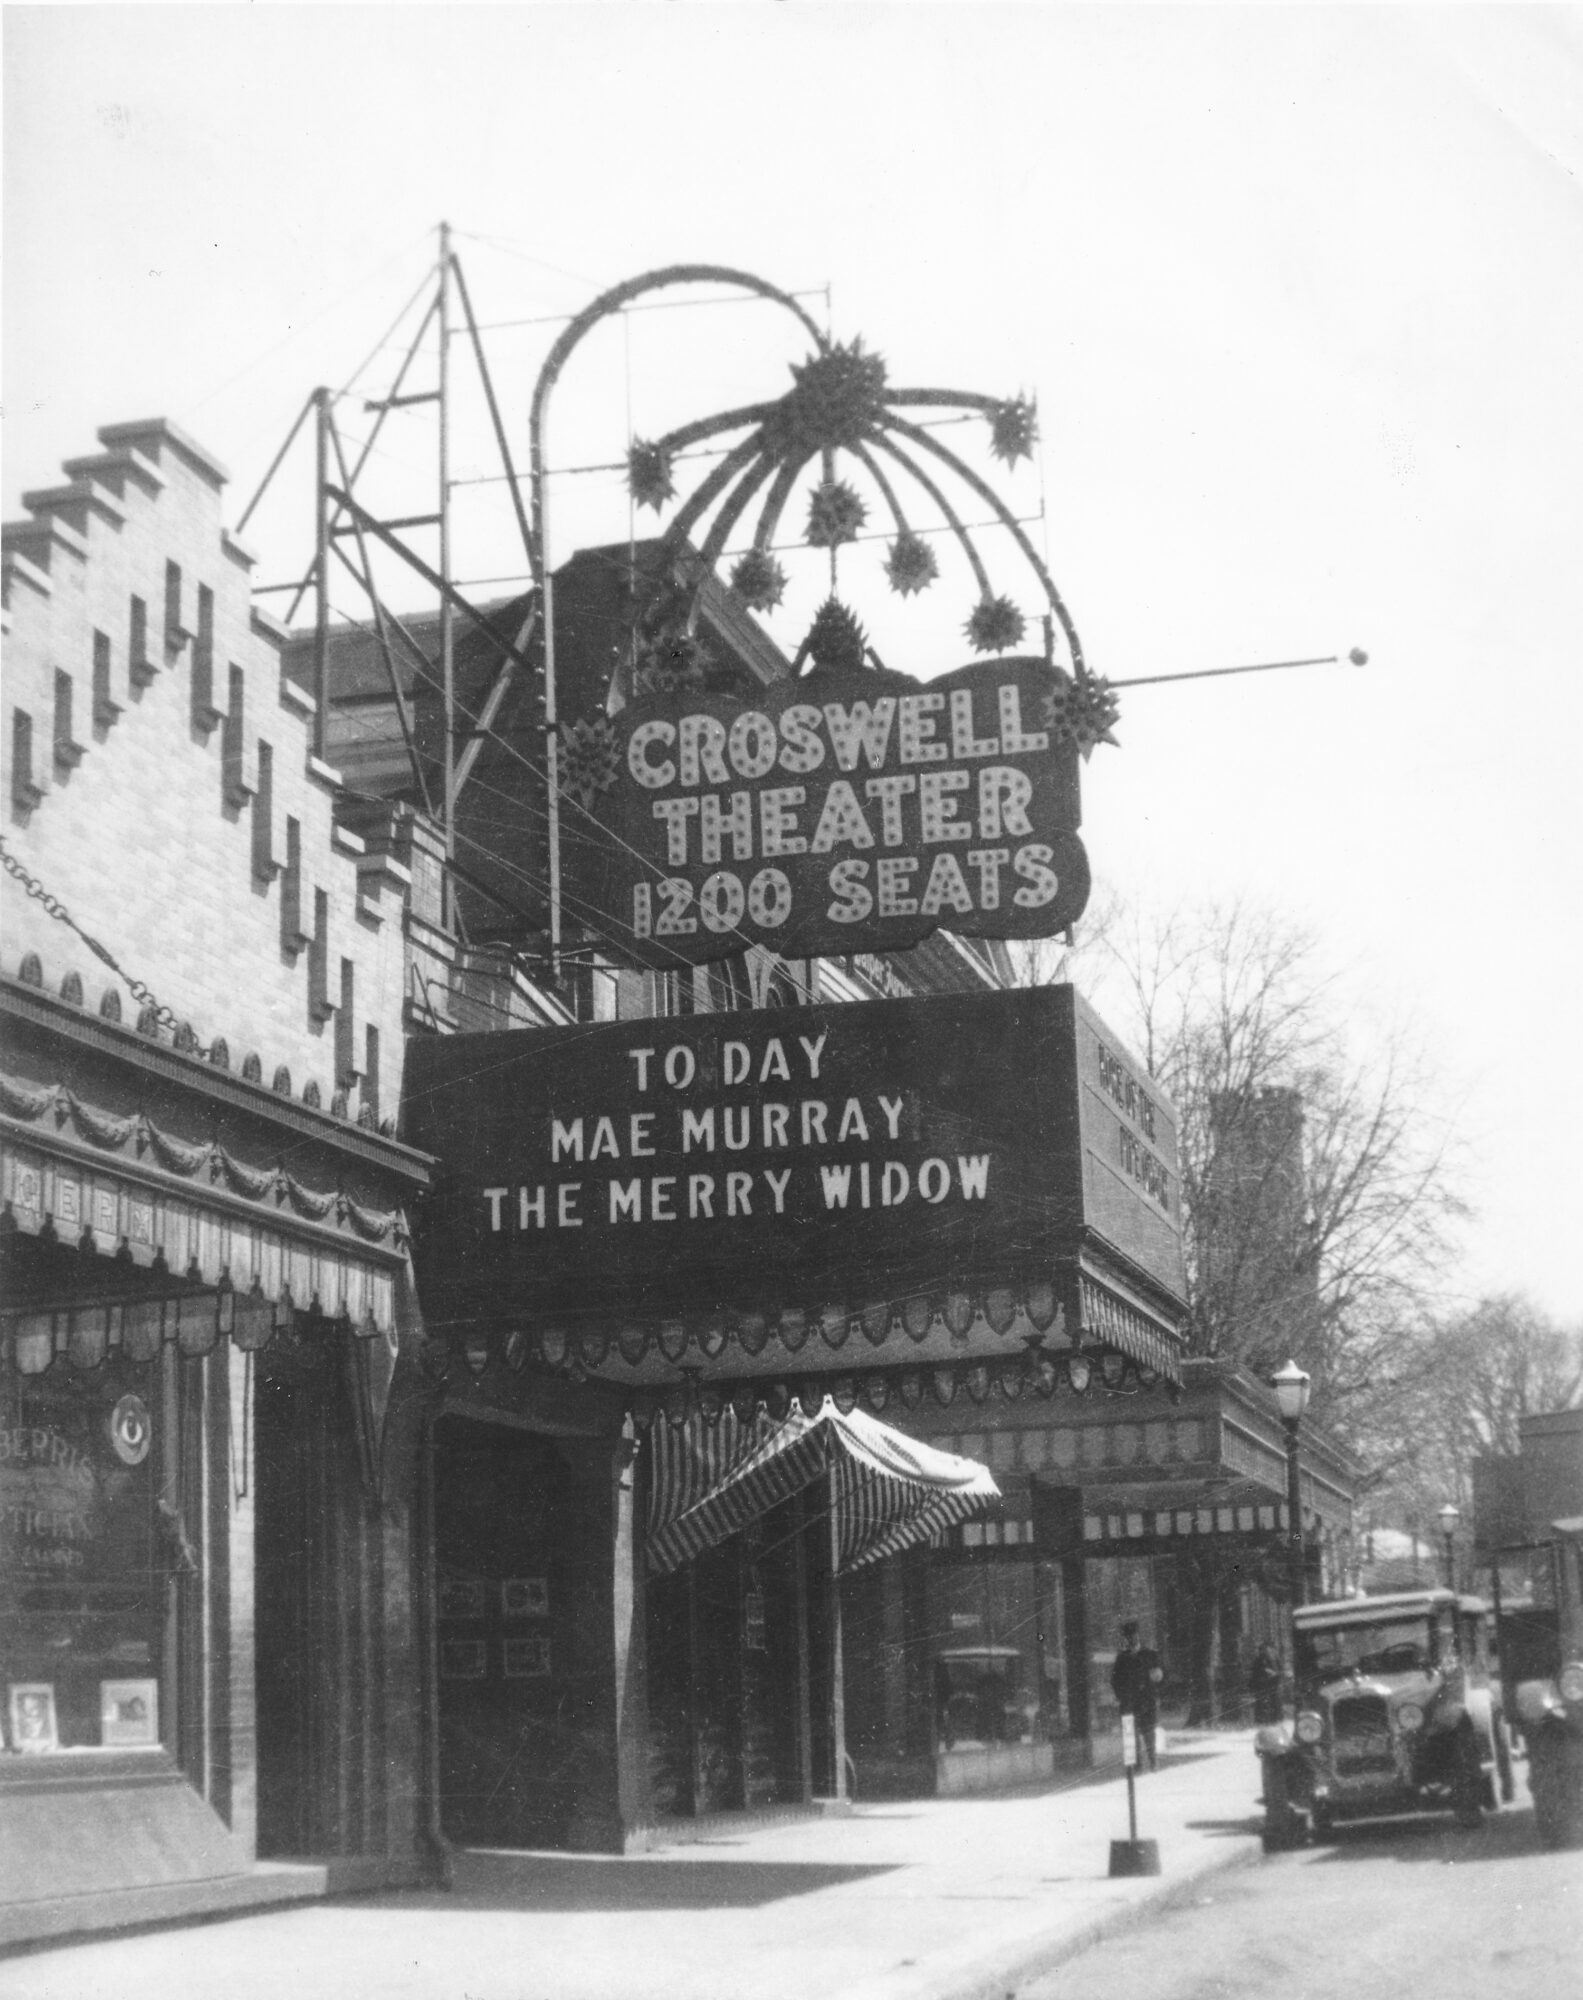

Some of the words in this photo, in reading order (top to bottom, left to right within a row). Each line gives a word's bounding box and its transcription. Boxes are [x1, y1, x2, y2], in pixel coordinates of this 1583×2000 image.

[628, 684, 1049, 788] CROSWELL
[652, 766, 1034, 866] THEATER
[633, 868, 792, 939] 1200
[826, 844, 1059, 924] SEATS
[723, 1035, 827, 1086] DAY
[552, 1113, 656, 1163] MAE
[682, 1095, 903, 1154] MURRAY
[484, 1183, 584, 1232] THE
[608, 1169, 792, 1224] MERRY
[820, 1154, 991, 1210] WIDOW
